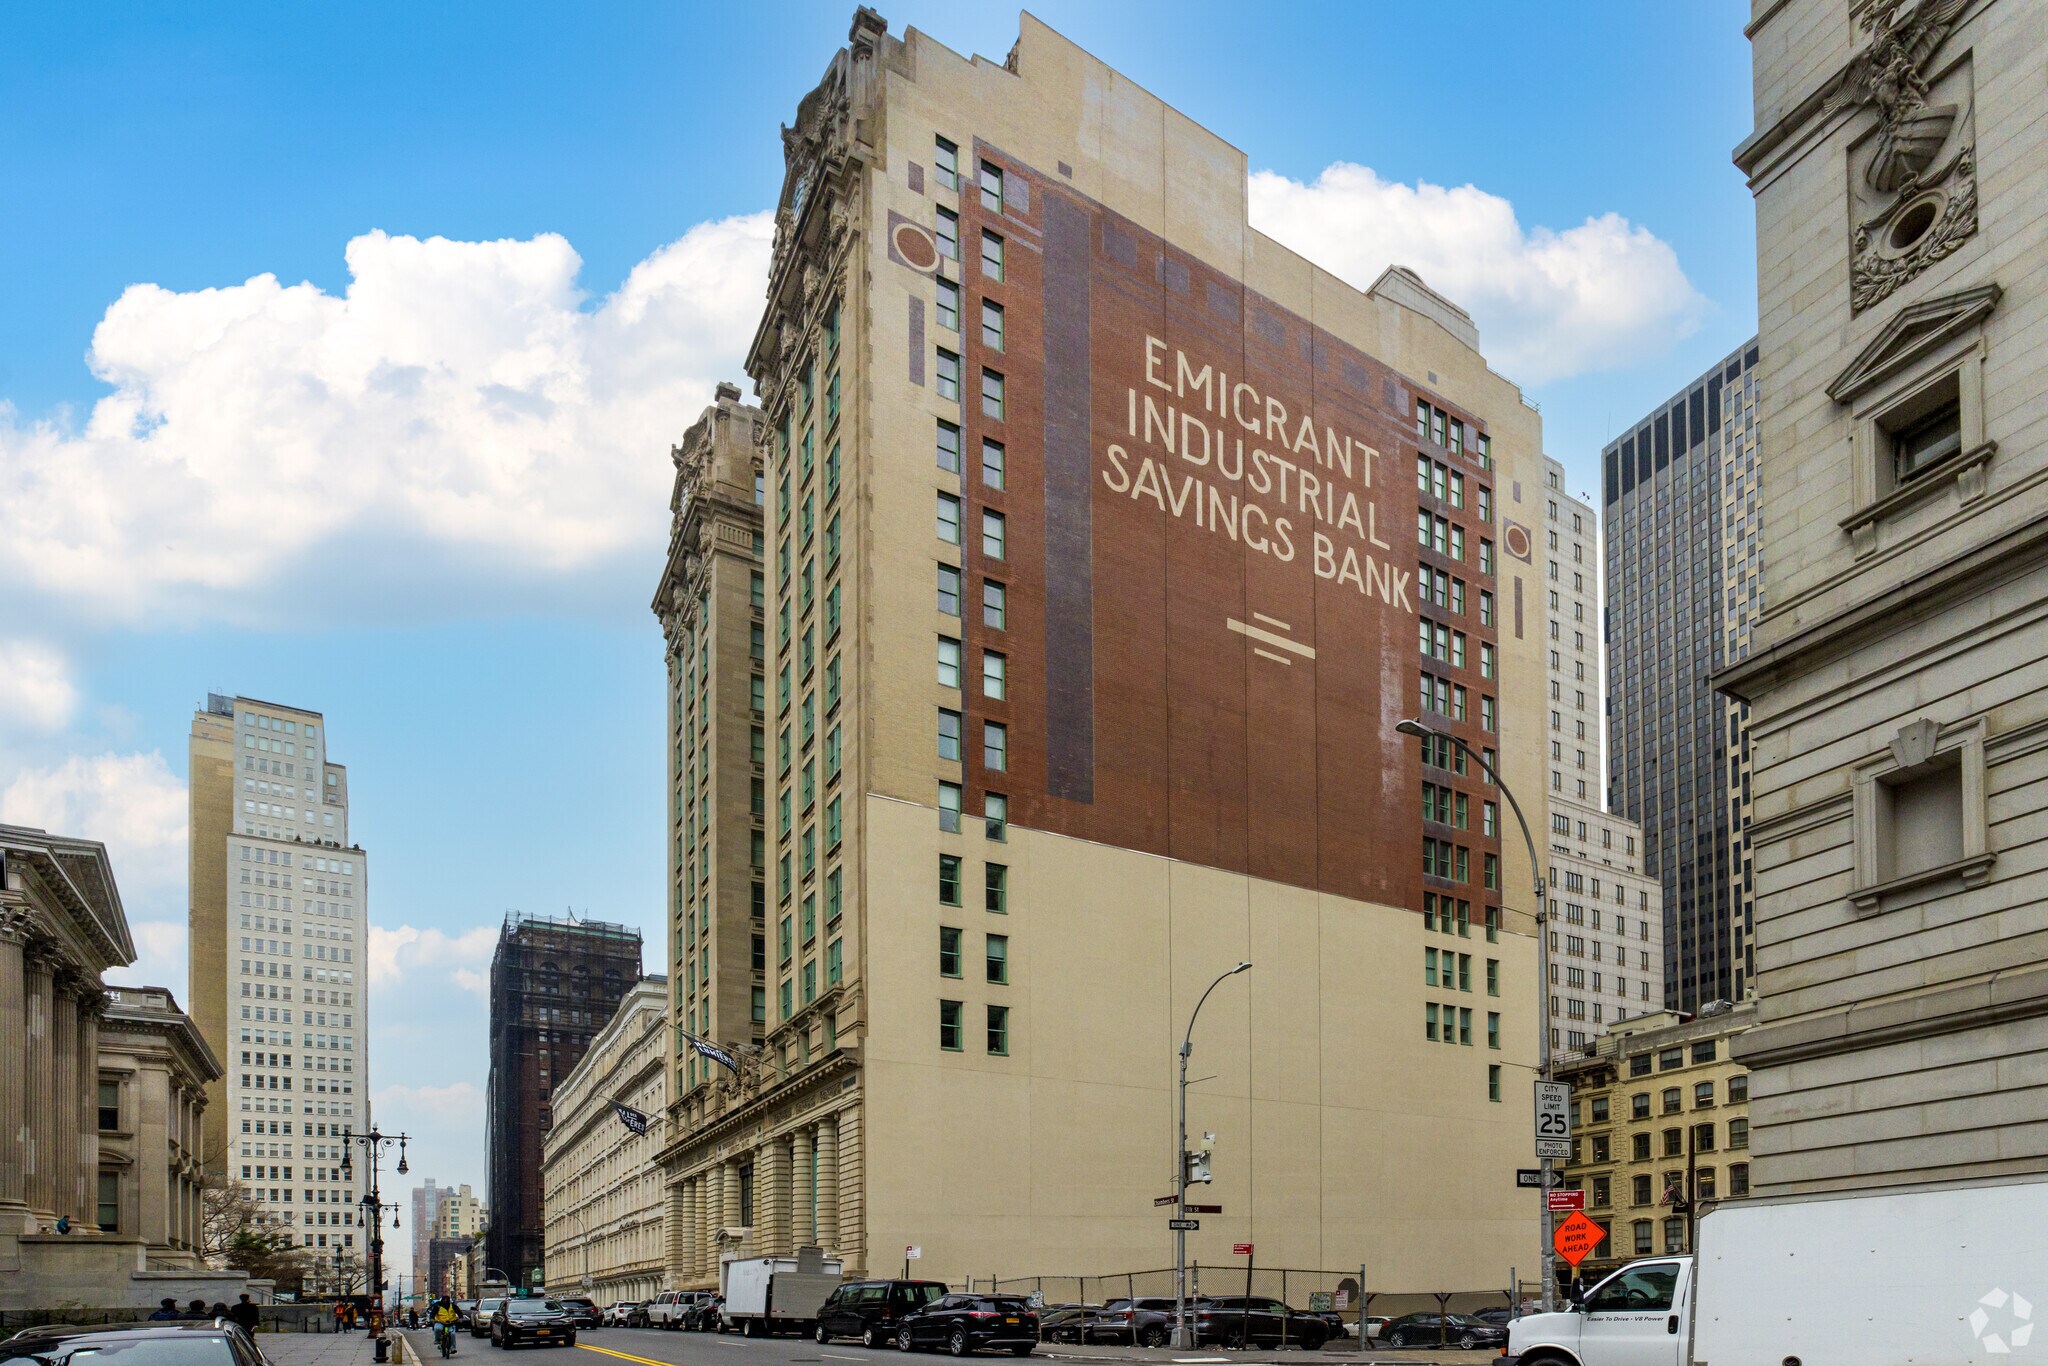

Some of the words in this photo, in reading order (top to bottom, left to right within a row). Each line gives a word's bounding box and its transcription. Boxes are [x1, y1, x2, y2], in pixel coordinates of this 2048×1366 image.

[1146, 334, 1380, 488] EMIGRANT
[1128, 388, 1391, 551] INDUSTRIAL
[1102, 444, 1295, 562] SAVINGS
[1313, 531, 1413, 614] BANK
[1544, 1085, 1559, 1093] CITY
[1541, 1094, 1562, 1102] SPEED
[1544, 1103, 1560, 1111] LIMIT
[1540, 1112, 1567, 1134] 25
[1539, 1148, 1569, 1156] ENFORCED
[1523, 1174, 1537, 1183] ONE
[1565, 1222, 1587, 1232] ROAD
[1565, 1232, 1587, 1242] WORK
[1562, 1243, 1589, 1253] AHEAD
